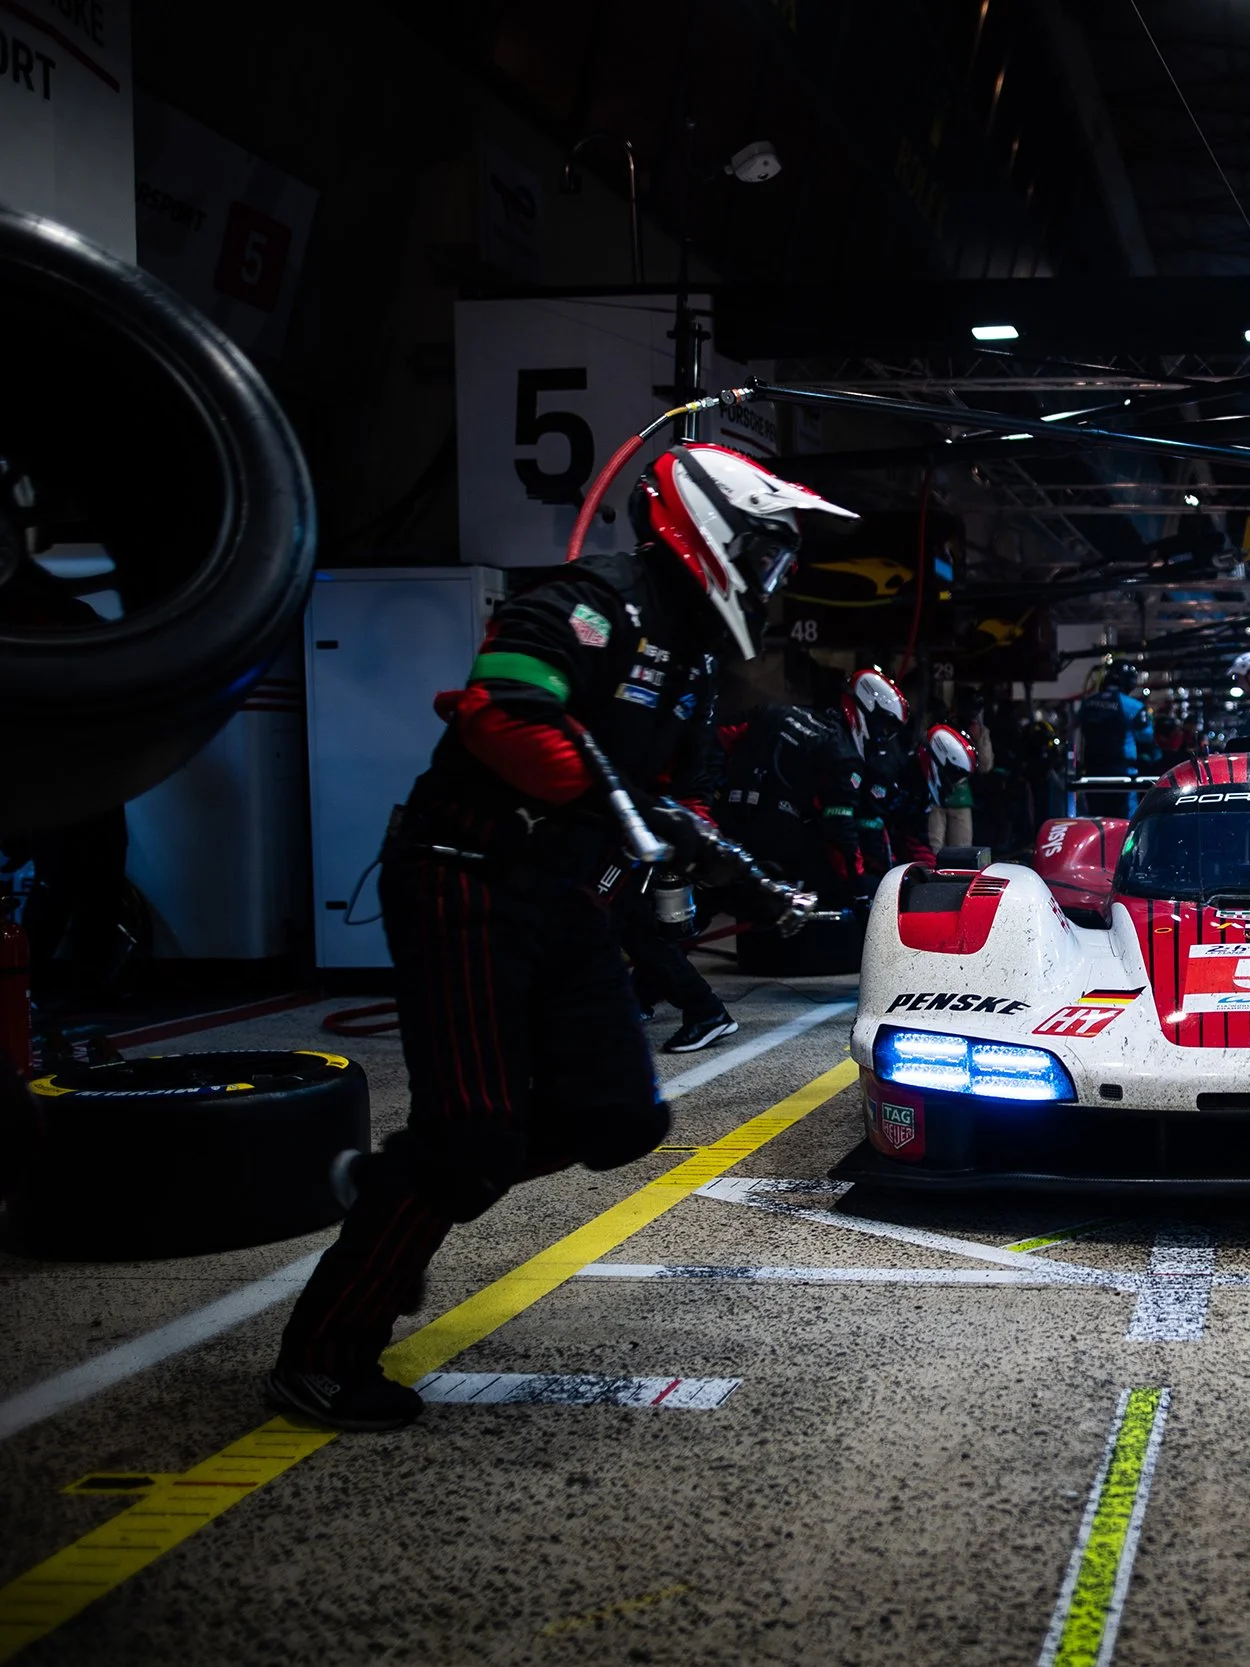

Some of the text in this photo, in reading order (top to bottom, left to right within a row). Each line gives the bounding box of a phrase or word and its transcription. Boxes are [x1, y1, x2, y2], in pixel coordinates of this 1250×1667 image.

[240, 229, 269, 286] 5
[514, 367, 594, 504] 5
[789, 619, 818, 643] 48
[932, 661, 955, 681] 29
[885, 992, 1031, 1015] PENSKE
[1037, 1007, 1117, 1034] HY
[884, 1106, 911, 1124] TAG
[884, 1123, 912, 1145] HEUER
